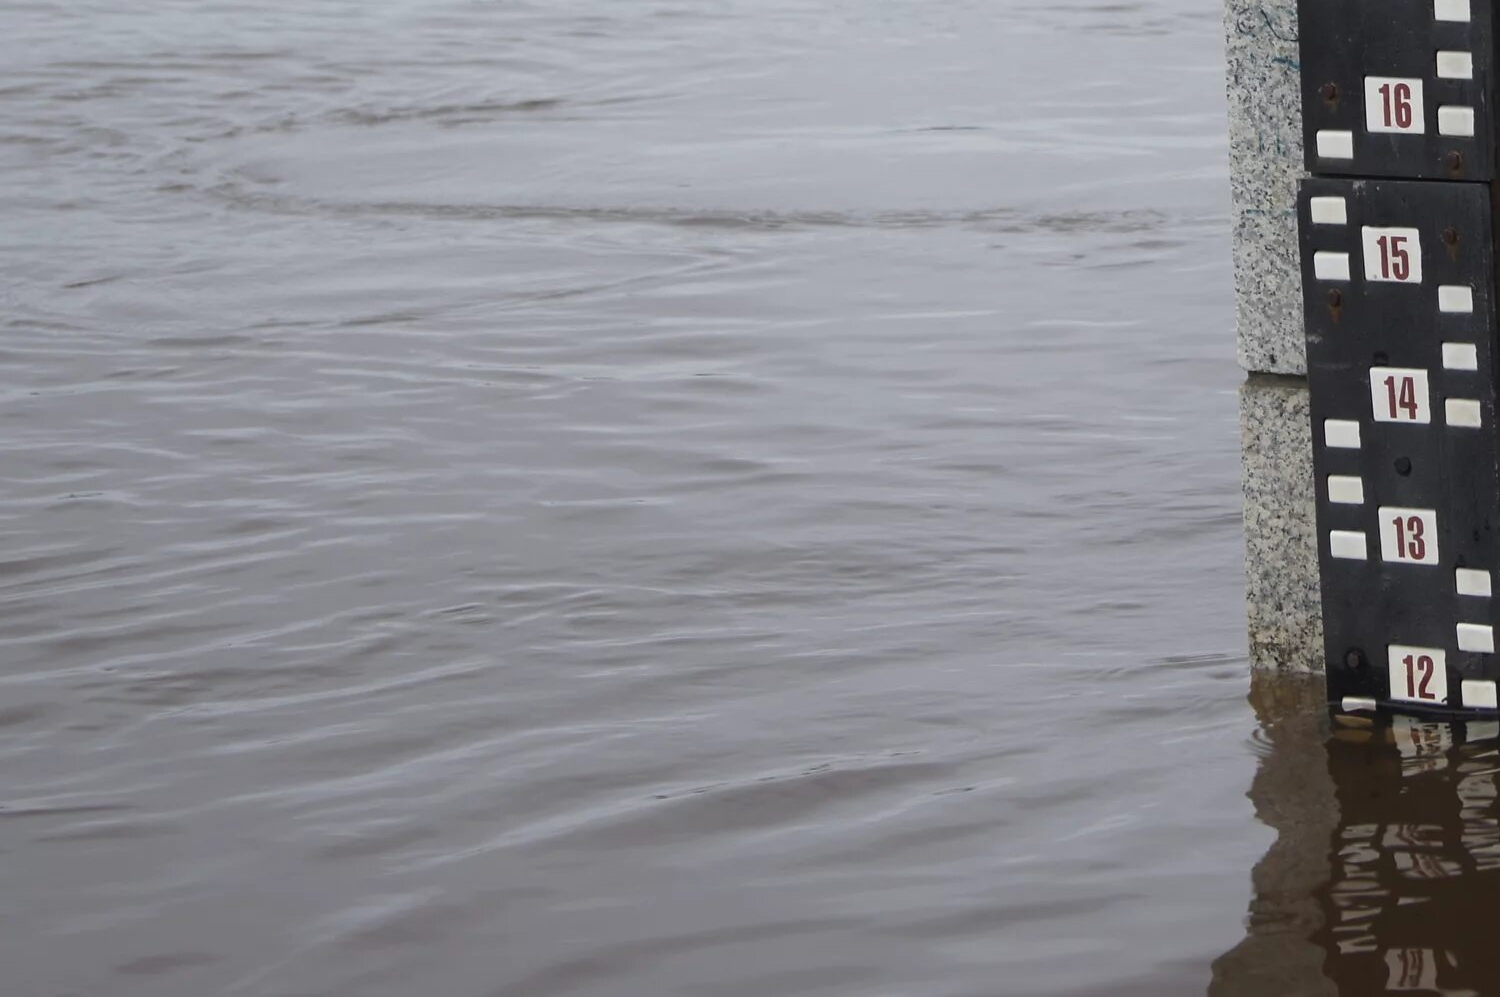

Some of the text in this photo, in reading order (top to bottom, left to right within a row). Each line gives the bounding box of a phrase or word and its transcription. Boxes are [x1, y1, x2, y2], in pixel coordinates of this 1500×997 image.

[1379, 83, 1411, 129] 16
[1376, 236, 1409, 280] 15
[1384, 376, 1417, 419] 14
[1392, 516, 1426, 560] 13
[1401, 655, 1436, 700] 12
